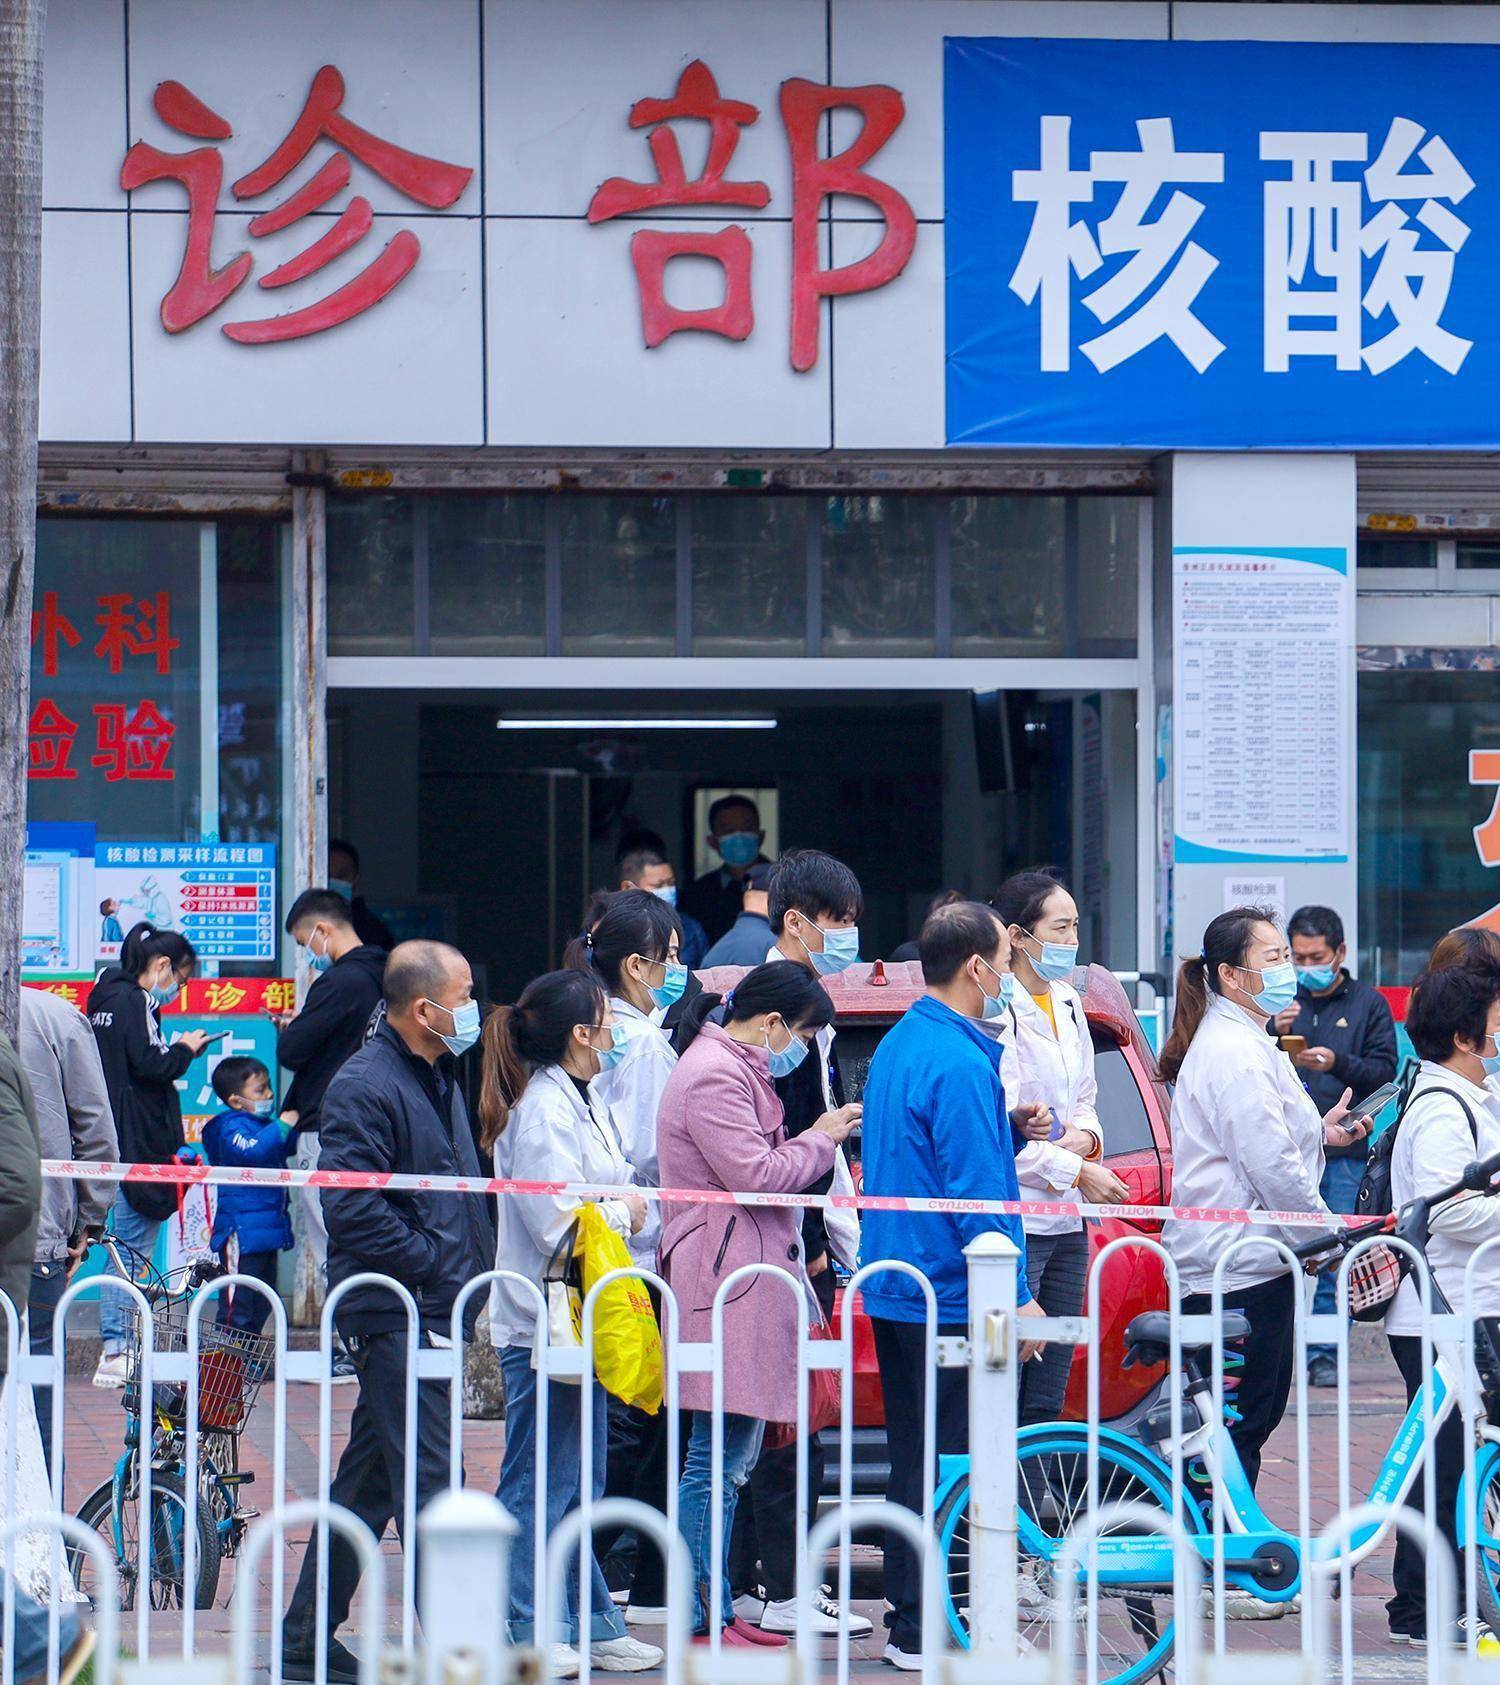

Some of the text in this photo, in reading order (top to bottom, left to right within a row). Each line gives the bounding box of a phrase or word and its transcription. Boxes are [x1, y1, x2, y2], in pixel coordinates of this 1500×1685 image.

[107, 847, 263, 863] 核酸检测采样流程图
